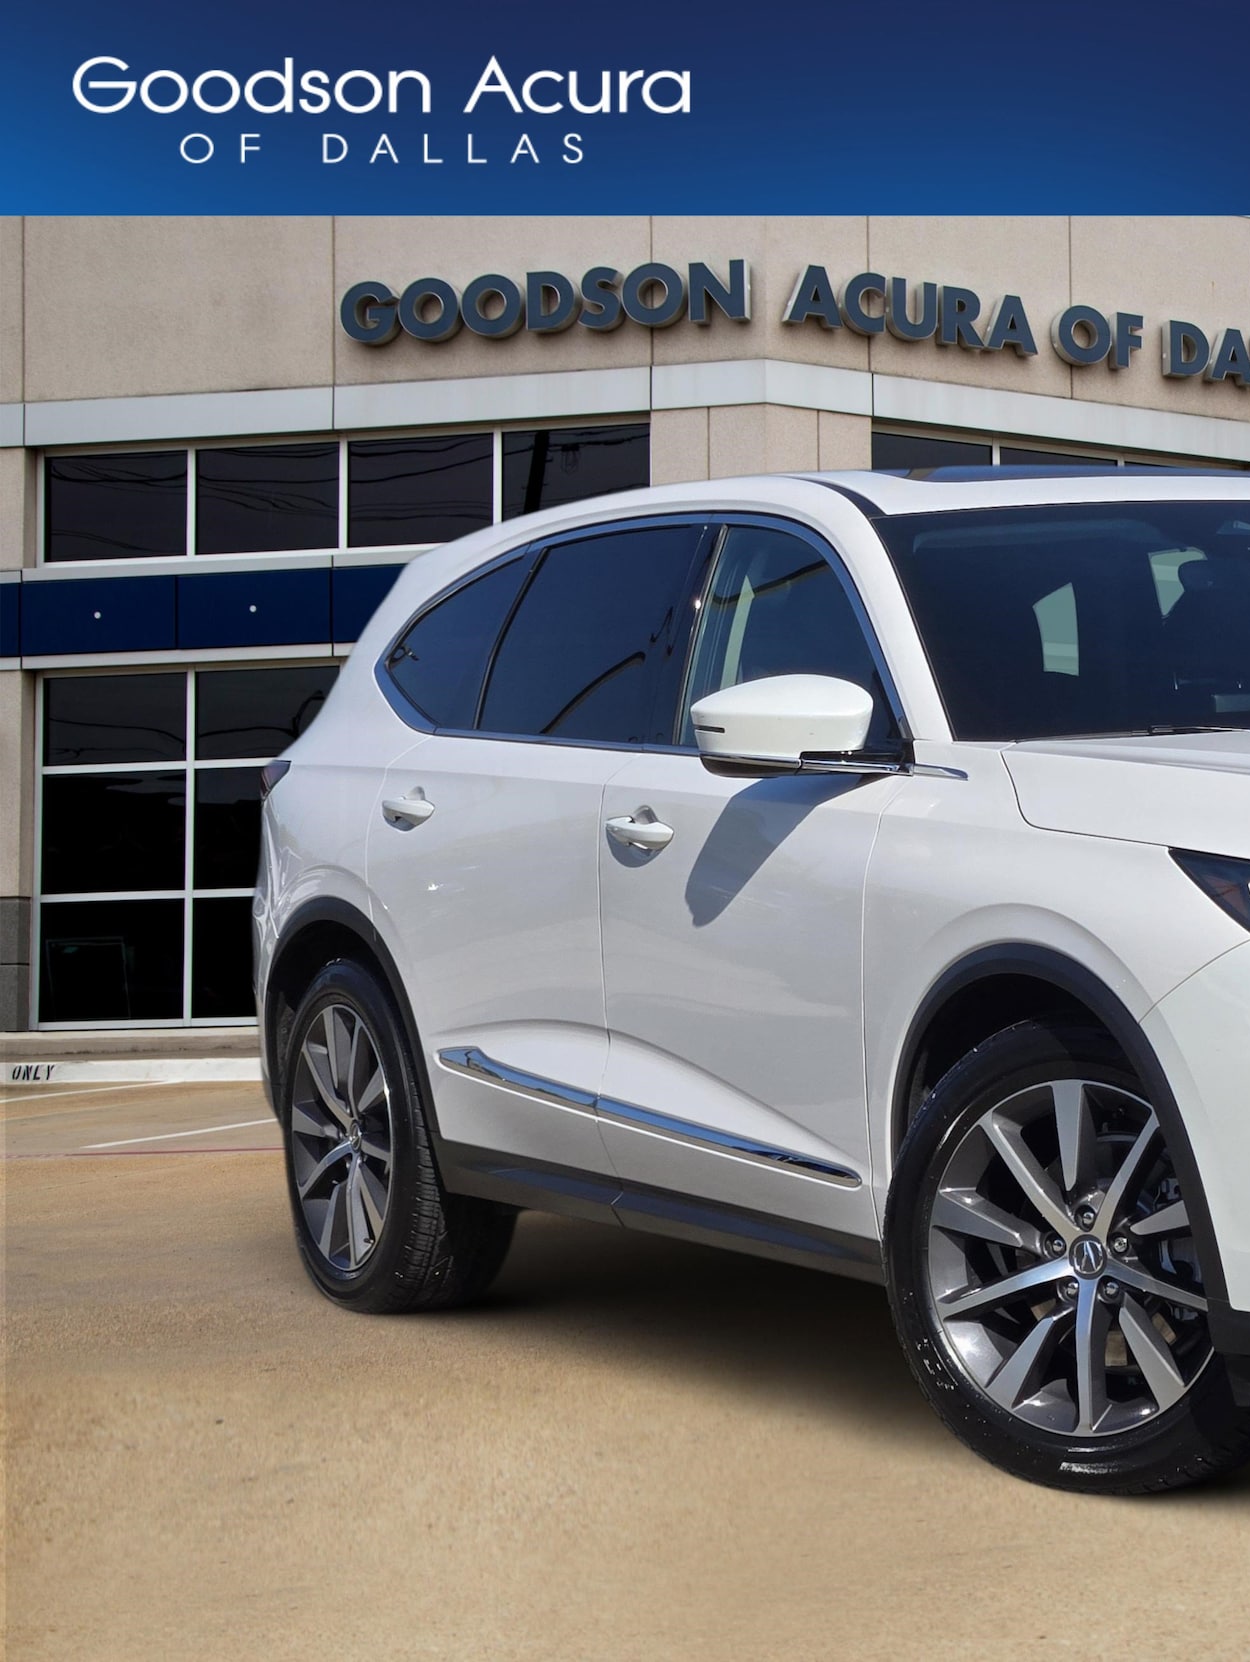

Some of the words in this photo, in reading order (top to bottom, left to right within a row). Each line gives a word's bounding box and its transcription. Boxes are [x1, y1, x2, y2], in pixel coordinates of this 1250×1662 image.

[340, 258, 751, 346] GOODSON
[782, 264, 1038, 357] ACURA
[1051, 304, 1144, 370] OF
[12, 1064, 55, 1081] ONLY
